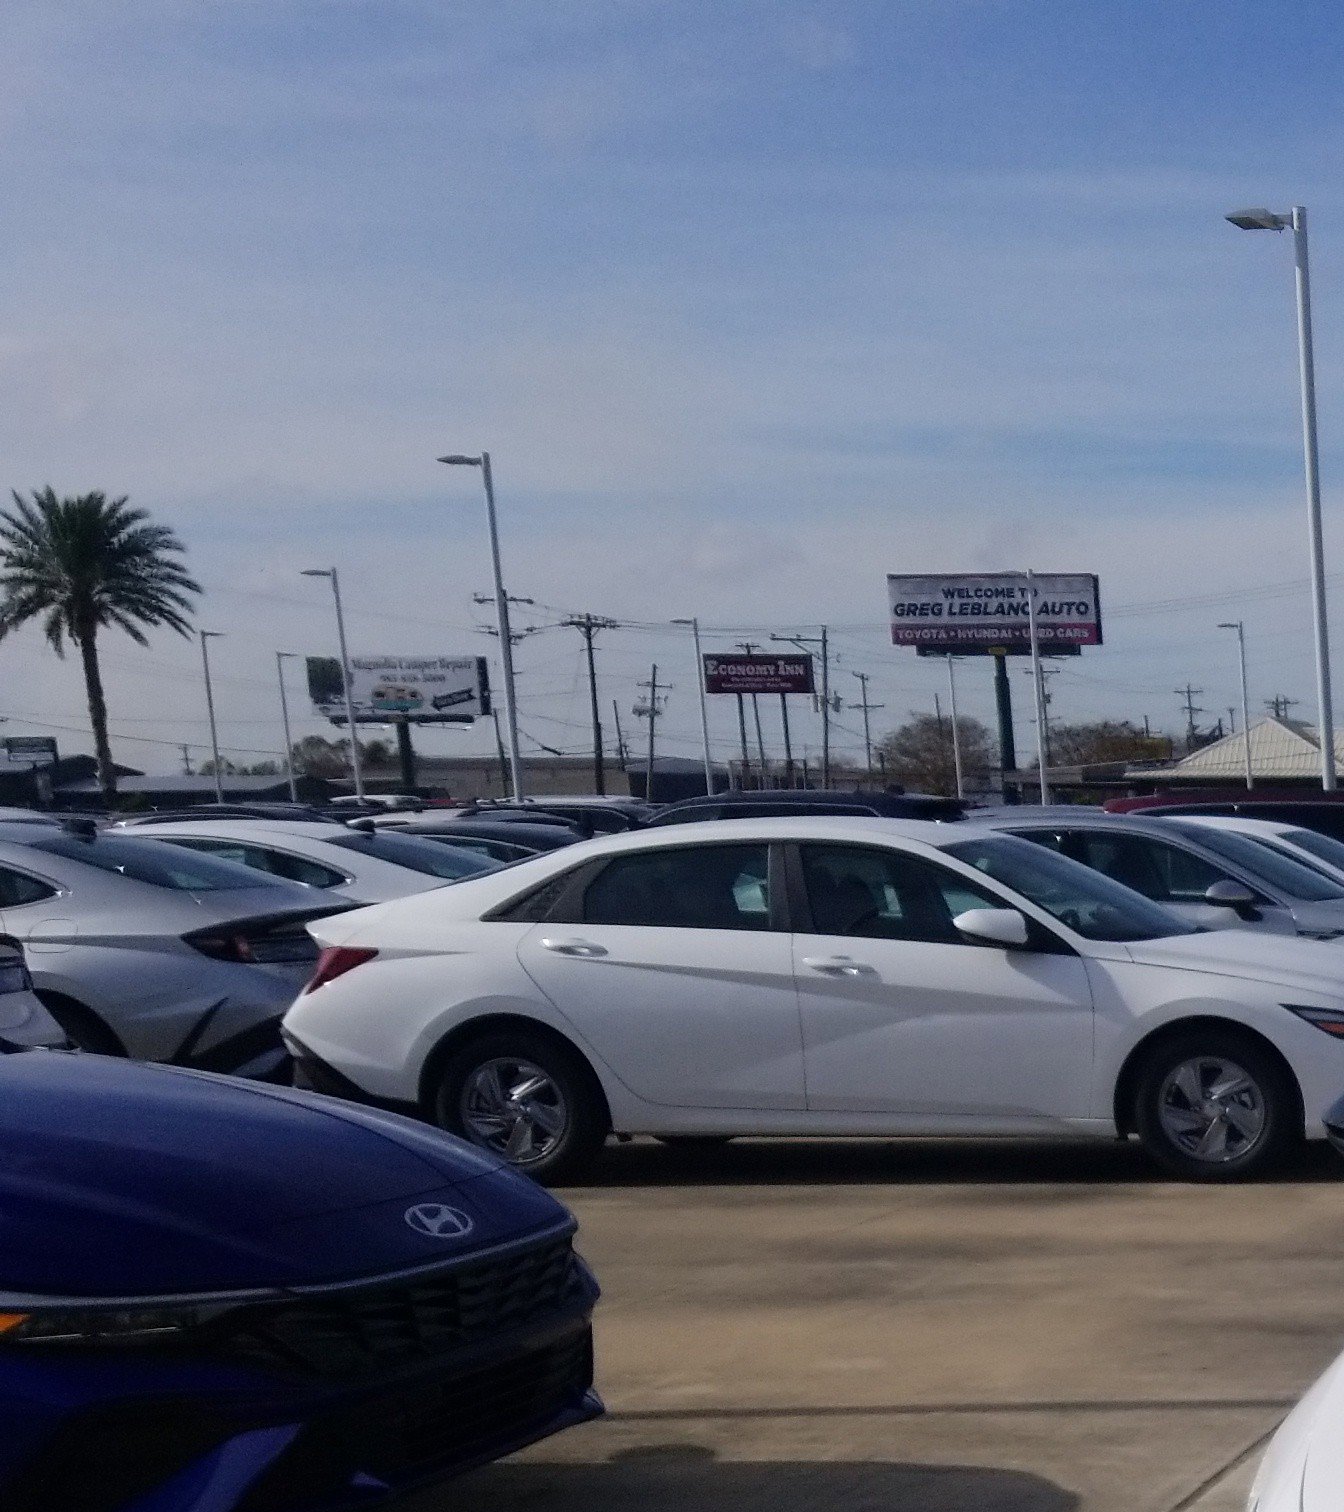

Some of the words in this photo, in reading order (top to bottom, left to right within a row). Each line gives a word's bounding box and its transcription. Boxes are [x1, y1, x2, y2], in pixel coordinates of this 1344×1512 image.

[942, 587, 1015, 599] WELCOME
[893, 601, 943, 617] GREG
[948, 601, 1031, 616] LEBLANC
[1037, 601, 1089, 616] AUTO
[897, 629, 947, 639] TOYOTA
[957, 628, 1012, 639] HYUNDAI
[1056, 628, 1090, 638] CARS
[705, 660, 776, 675] ECONOMY
